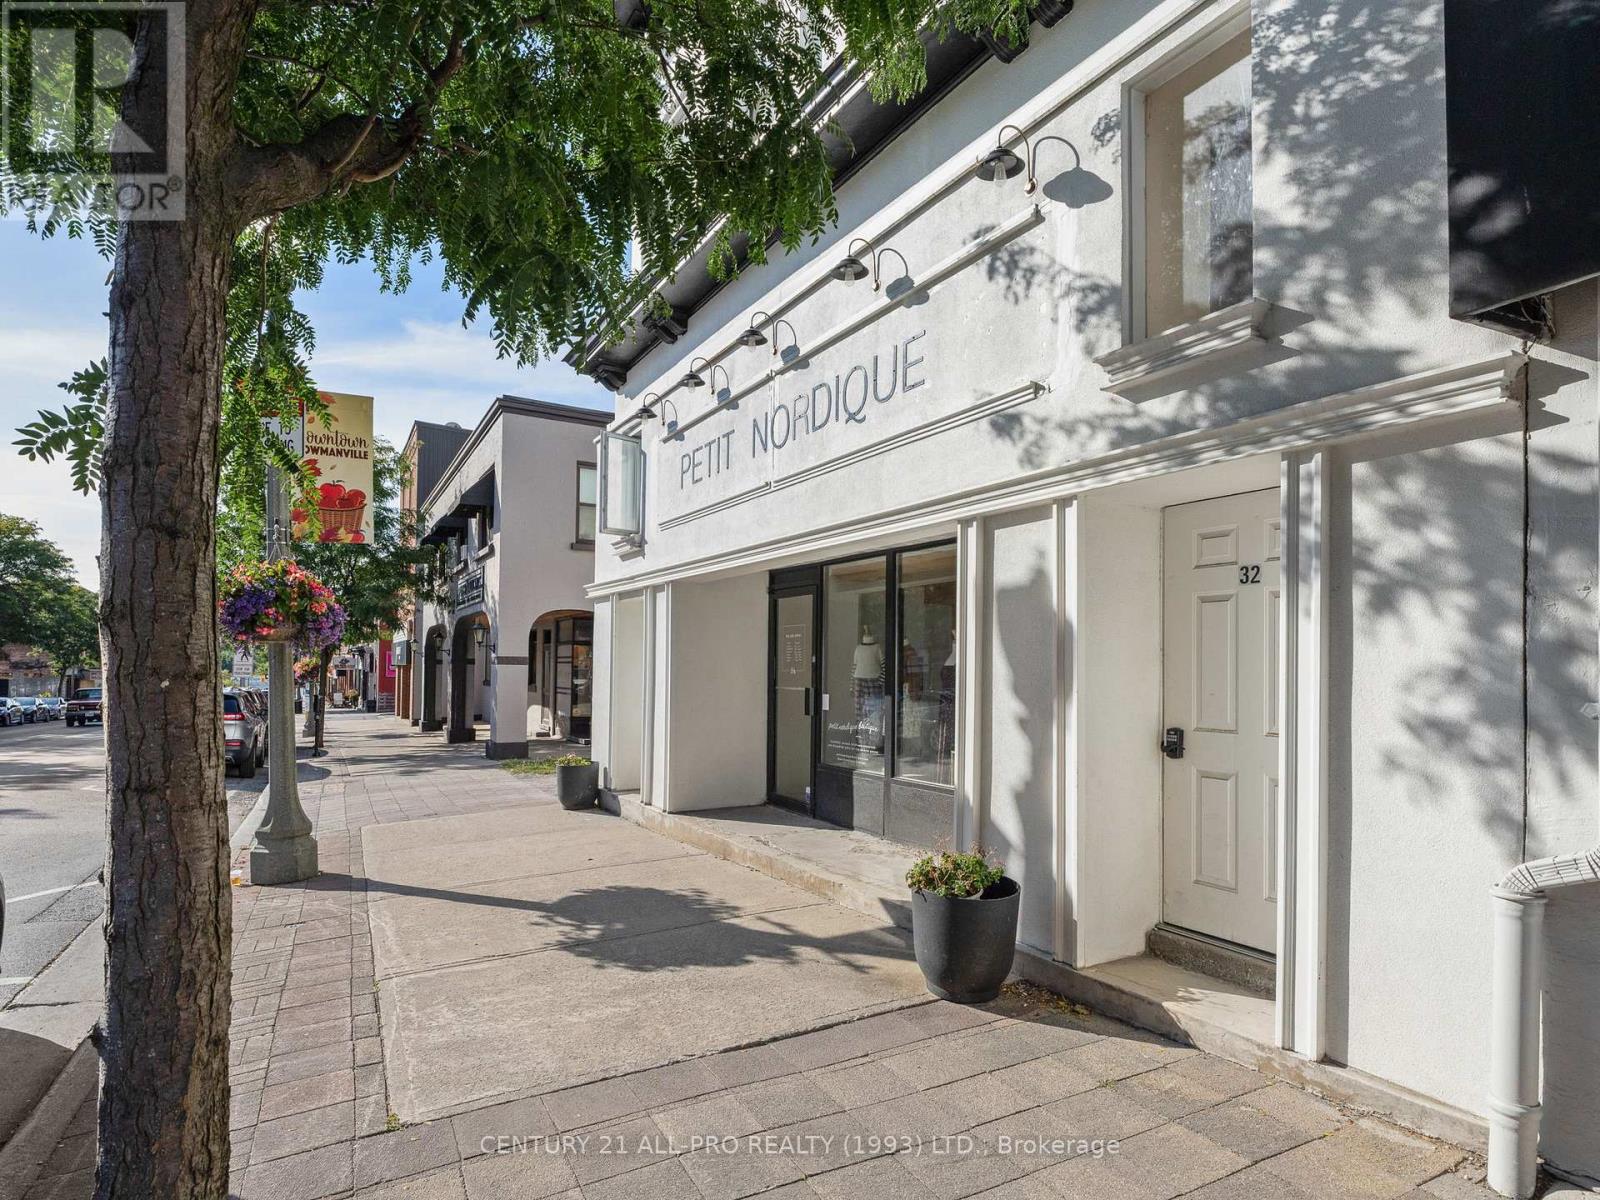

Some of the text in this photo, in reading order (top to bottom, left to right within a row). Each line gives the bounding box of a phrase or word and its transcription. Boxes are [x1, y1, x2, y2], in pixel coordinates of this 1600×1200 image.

[680, 329, 926, 490] PETIT NORDIQUE
[306, 429, 370, 449] owntown
[304, 444, 369, 460] OWMANVILLE
[1239, 565, 1261, 584] 32
